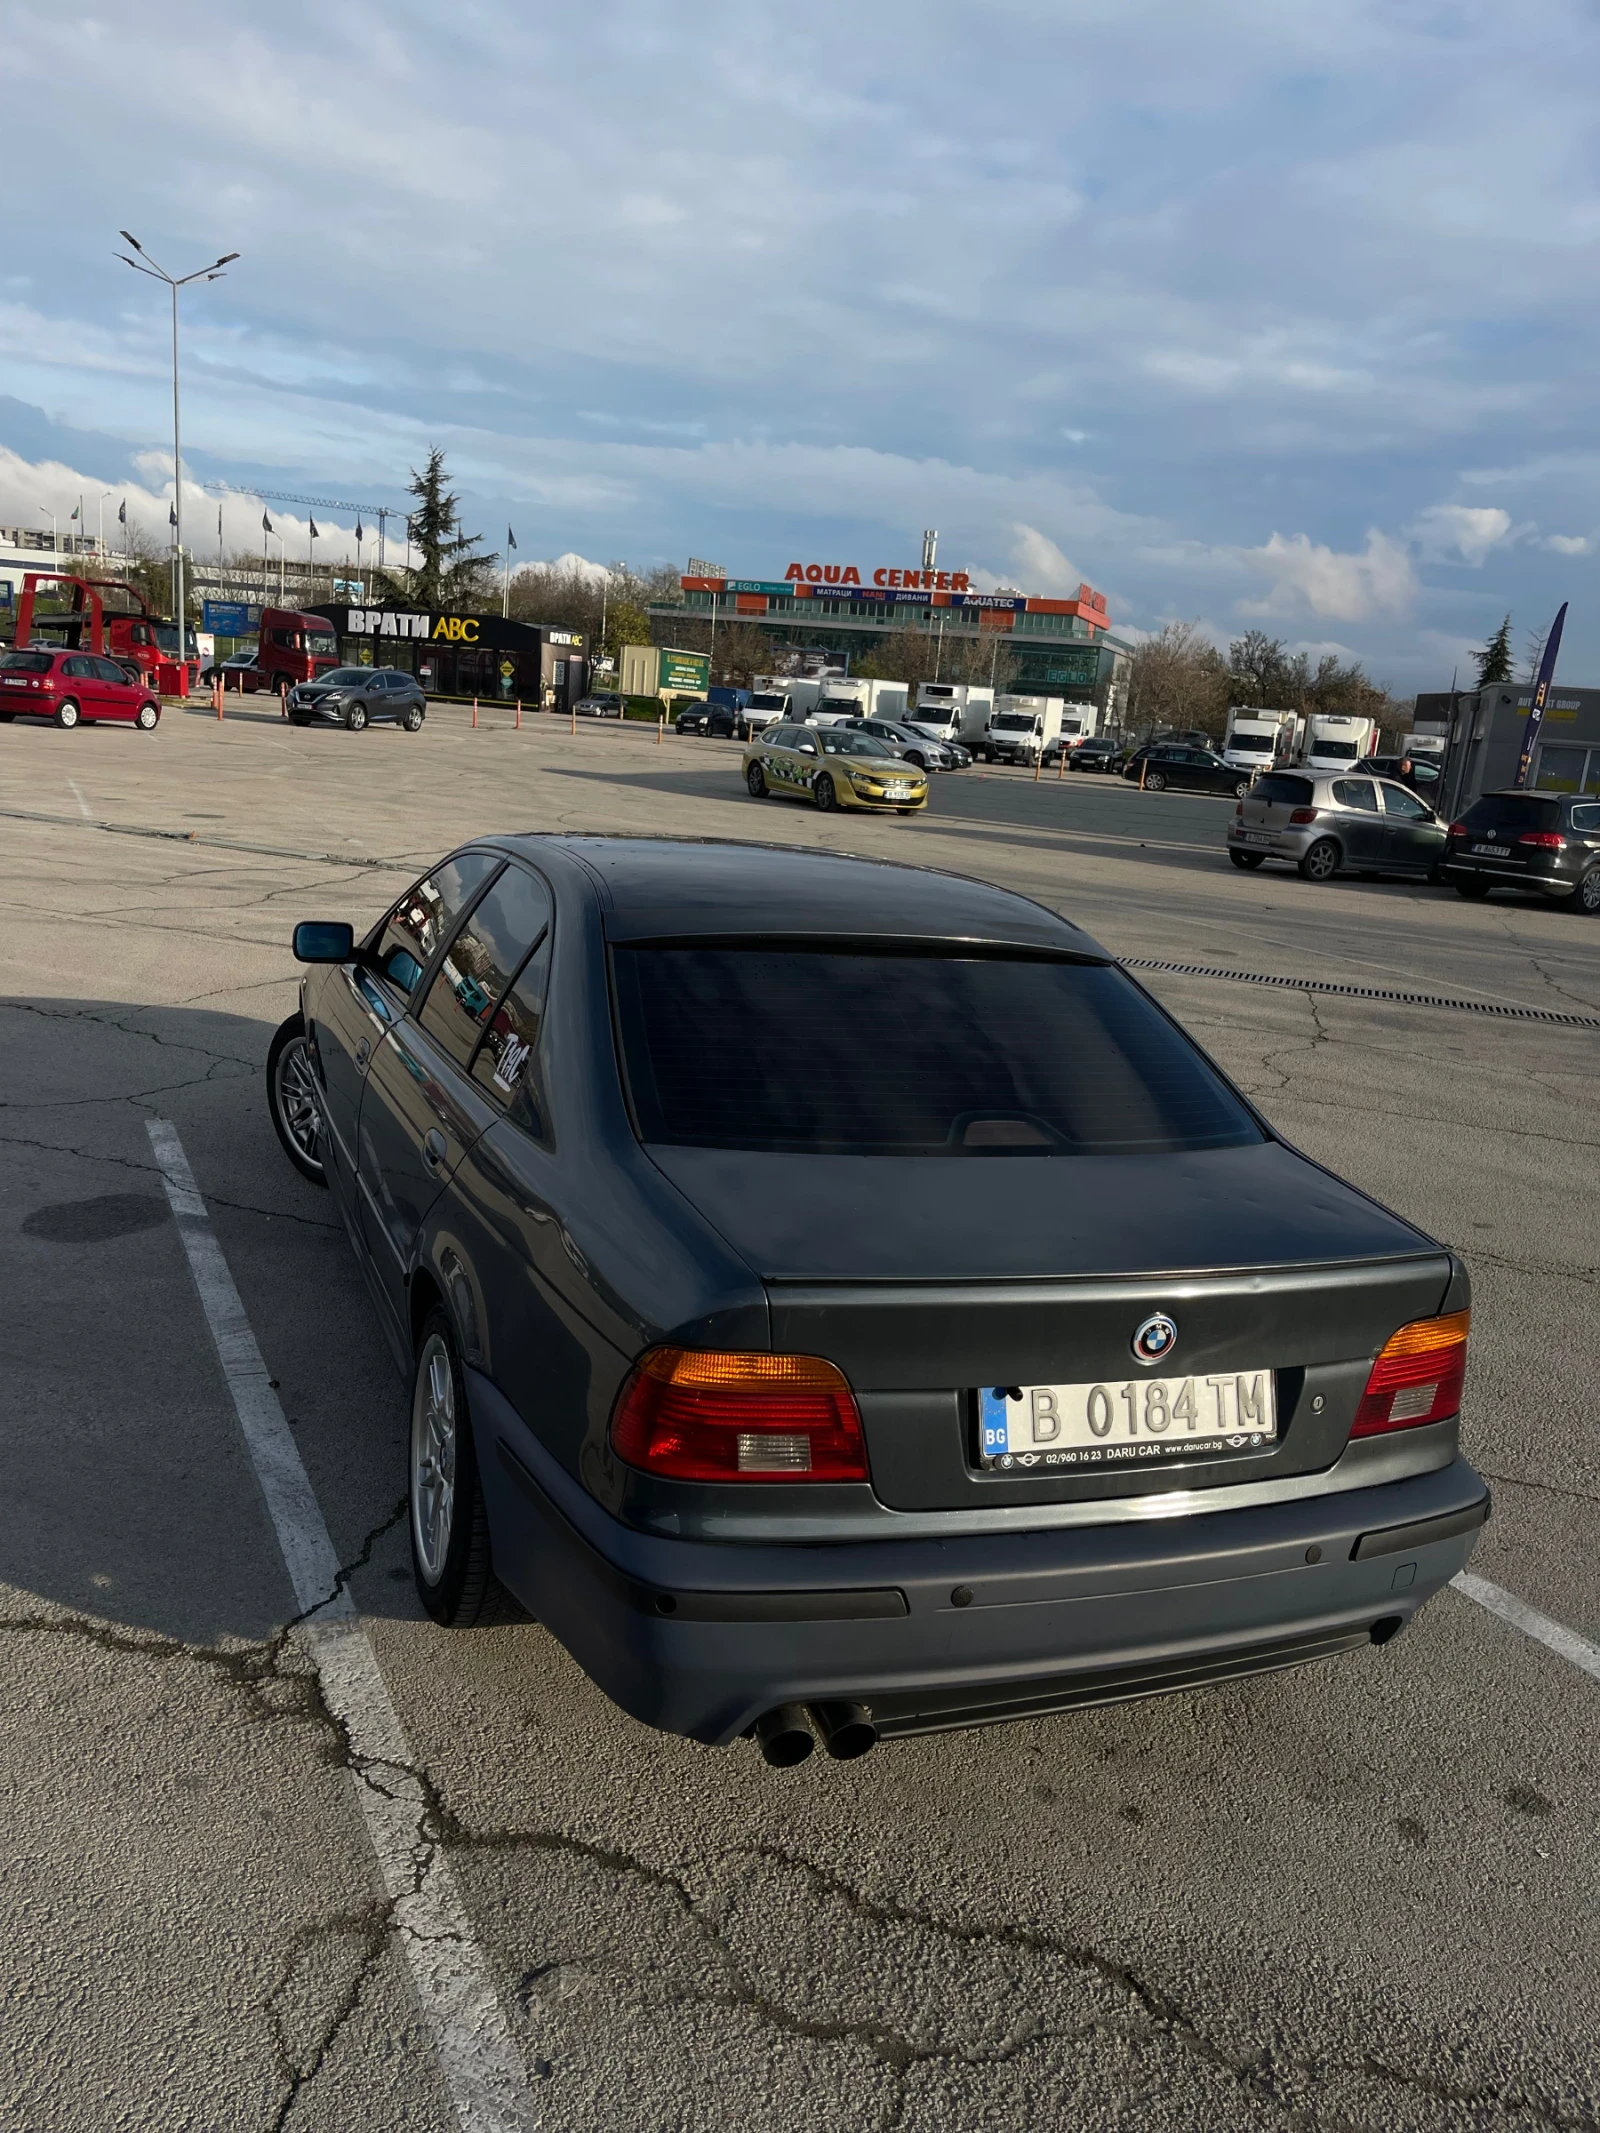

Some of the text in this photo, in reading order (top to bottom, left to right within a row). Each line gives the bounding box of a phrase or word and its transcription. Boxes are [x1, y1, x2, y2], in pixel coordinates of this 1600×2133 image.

[785, 563, 970, 592] AQUA CENTER
[738, 582, 761, 592] EGLO
[816, 588, 853, 598] МАТРАЦИ
[895, 593, 929, 602] ДИВАНИ
[962, 596, 1015, 609] AQUATEC
[347, 609, 480, 642] ВРАТИ ABC
[550, 631, 572, 645] ВРАТИ
[1048, 670, 1087, 684] EGLO
[1031, 1374, 1266, 1443] B 0184 TM
[985, 1428, 1006, 1445] BG
[1046, 1440, 1223, 1465] 02/960 16 23 DARU CAR www.darucar.bg
